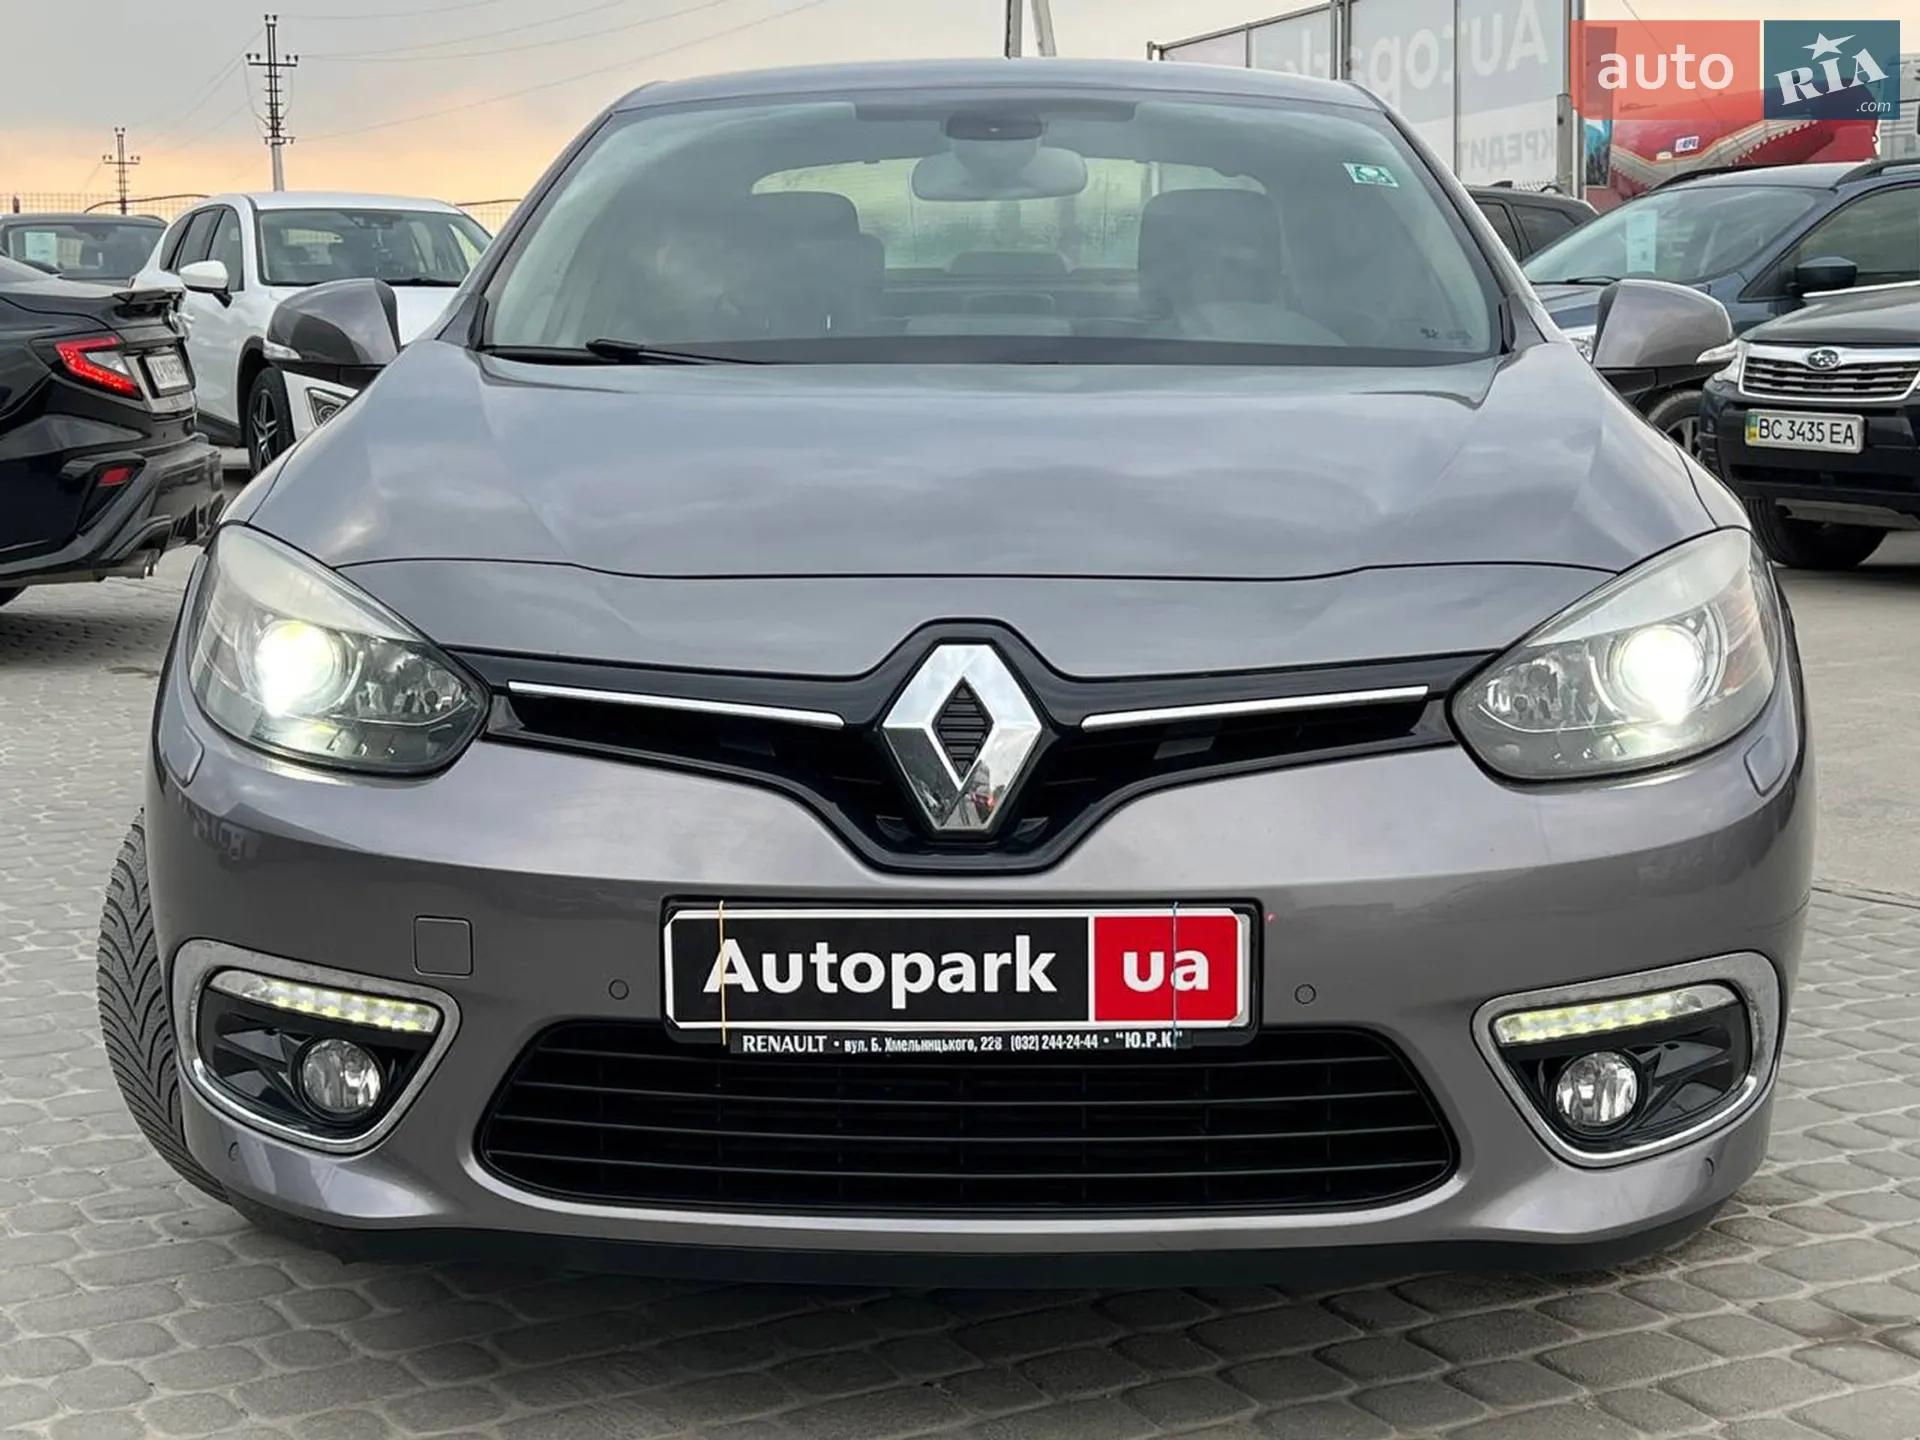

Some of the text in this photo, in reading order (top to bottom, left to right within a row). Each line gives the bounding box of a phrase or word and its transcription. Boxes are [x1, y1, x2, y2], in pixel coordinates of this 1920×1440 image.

[1759, 418, 1855, 445] BC 3435 EA
[703, 935, 1209, 1009] Autopark ua
[742, 1035, 828, 1053] RENAULT
[844, 1039, 868, 1054] вул.
[871, 1037, 882, 1052] Б.
[1010, 1034, 1039, 1052] (032)
[1041, 1034, 1098, 1050] 244-24-44
